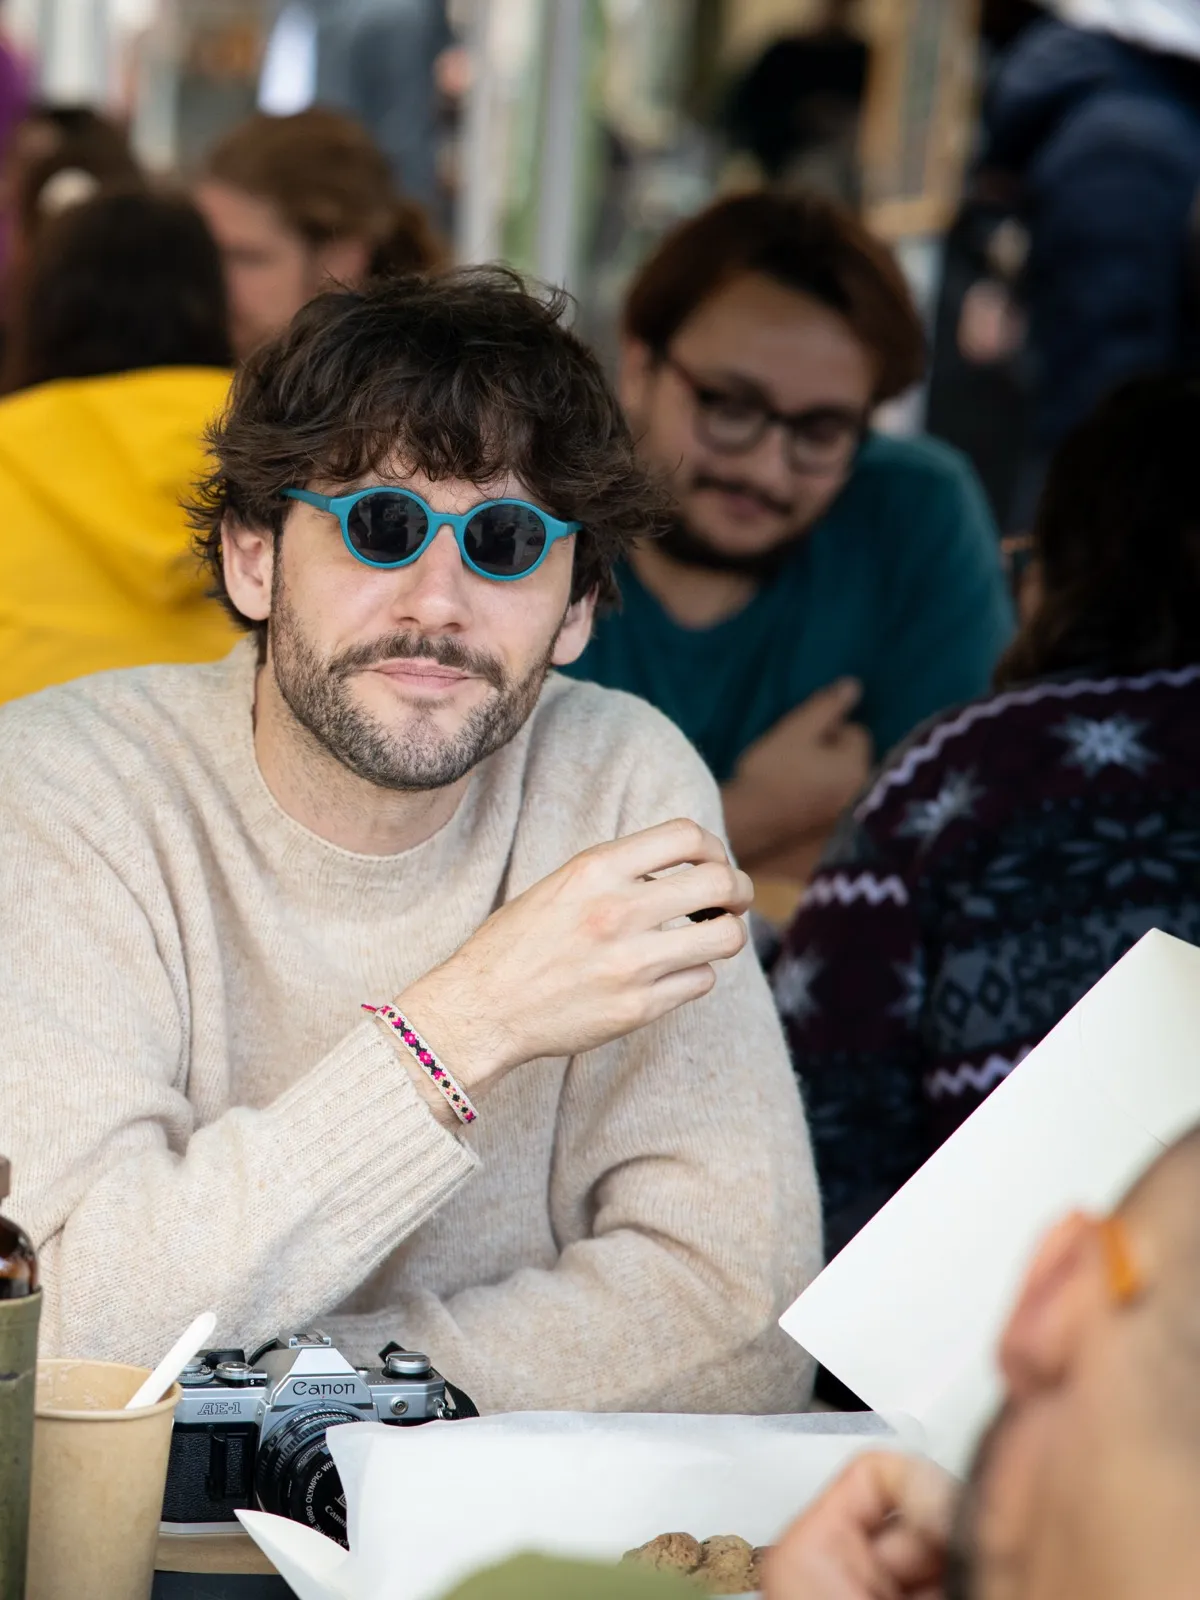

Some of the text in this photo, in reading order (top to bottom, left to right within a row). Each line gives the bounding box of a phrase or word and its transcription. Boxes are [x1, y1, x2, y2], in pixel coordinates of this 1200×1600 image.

[292, 1381, 355, 1396] Canon
[197, 1402, 242, 1416] AE-1
[305, 1471, 322, 1503] OLYMPIC
[306, 1505, 316, 1524] 1980
